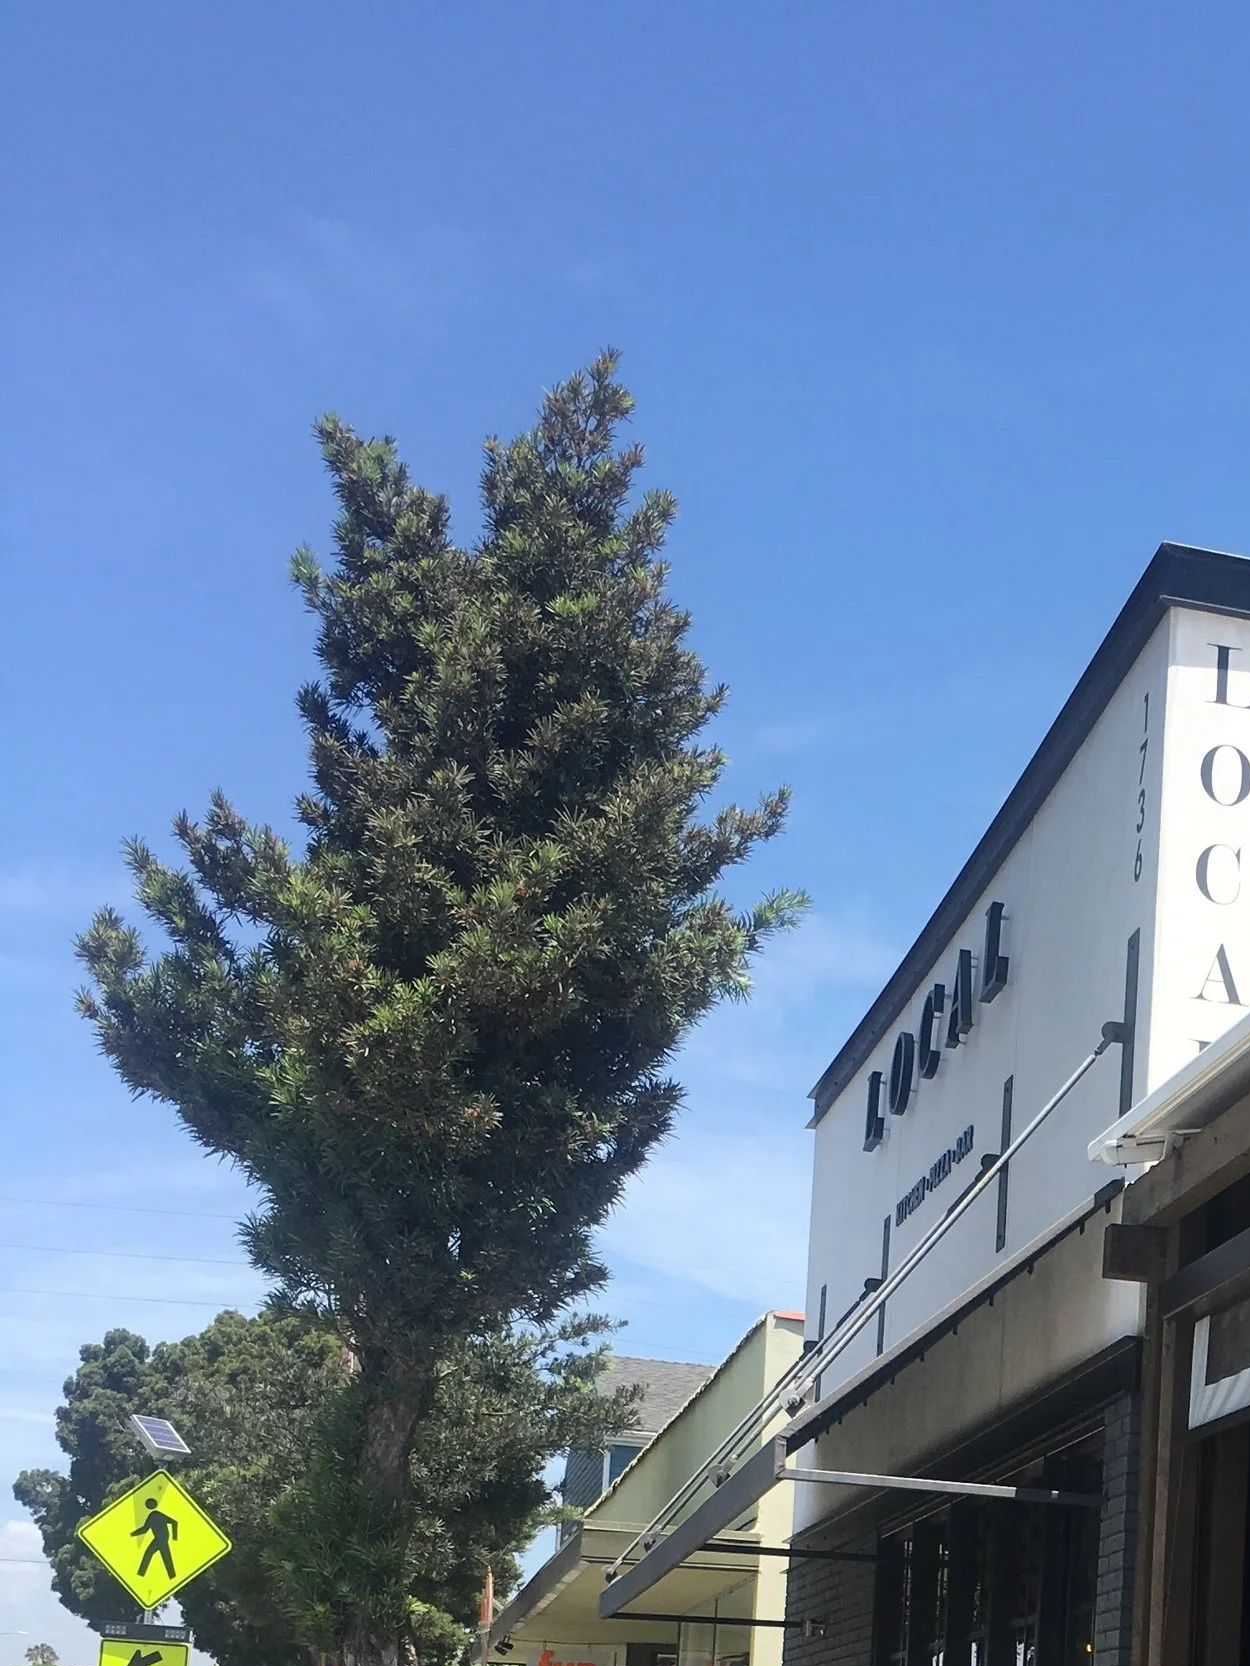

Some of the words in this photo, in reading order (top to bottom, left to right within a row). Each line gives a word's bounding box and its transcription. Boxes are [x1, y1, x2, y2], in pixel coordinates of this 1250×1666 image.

[1134, 692, 1150, 882] 1736
[863, 901, 1010, 1152] LOCAL
[895, 1176, 926, 1227] KITCHEN
